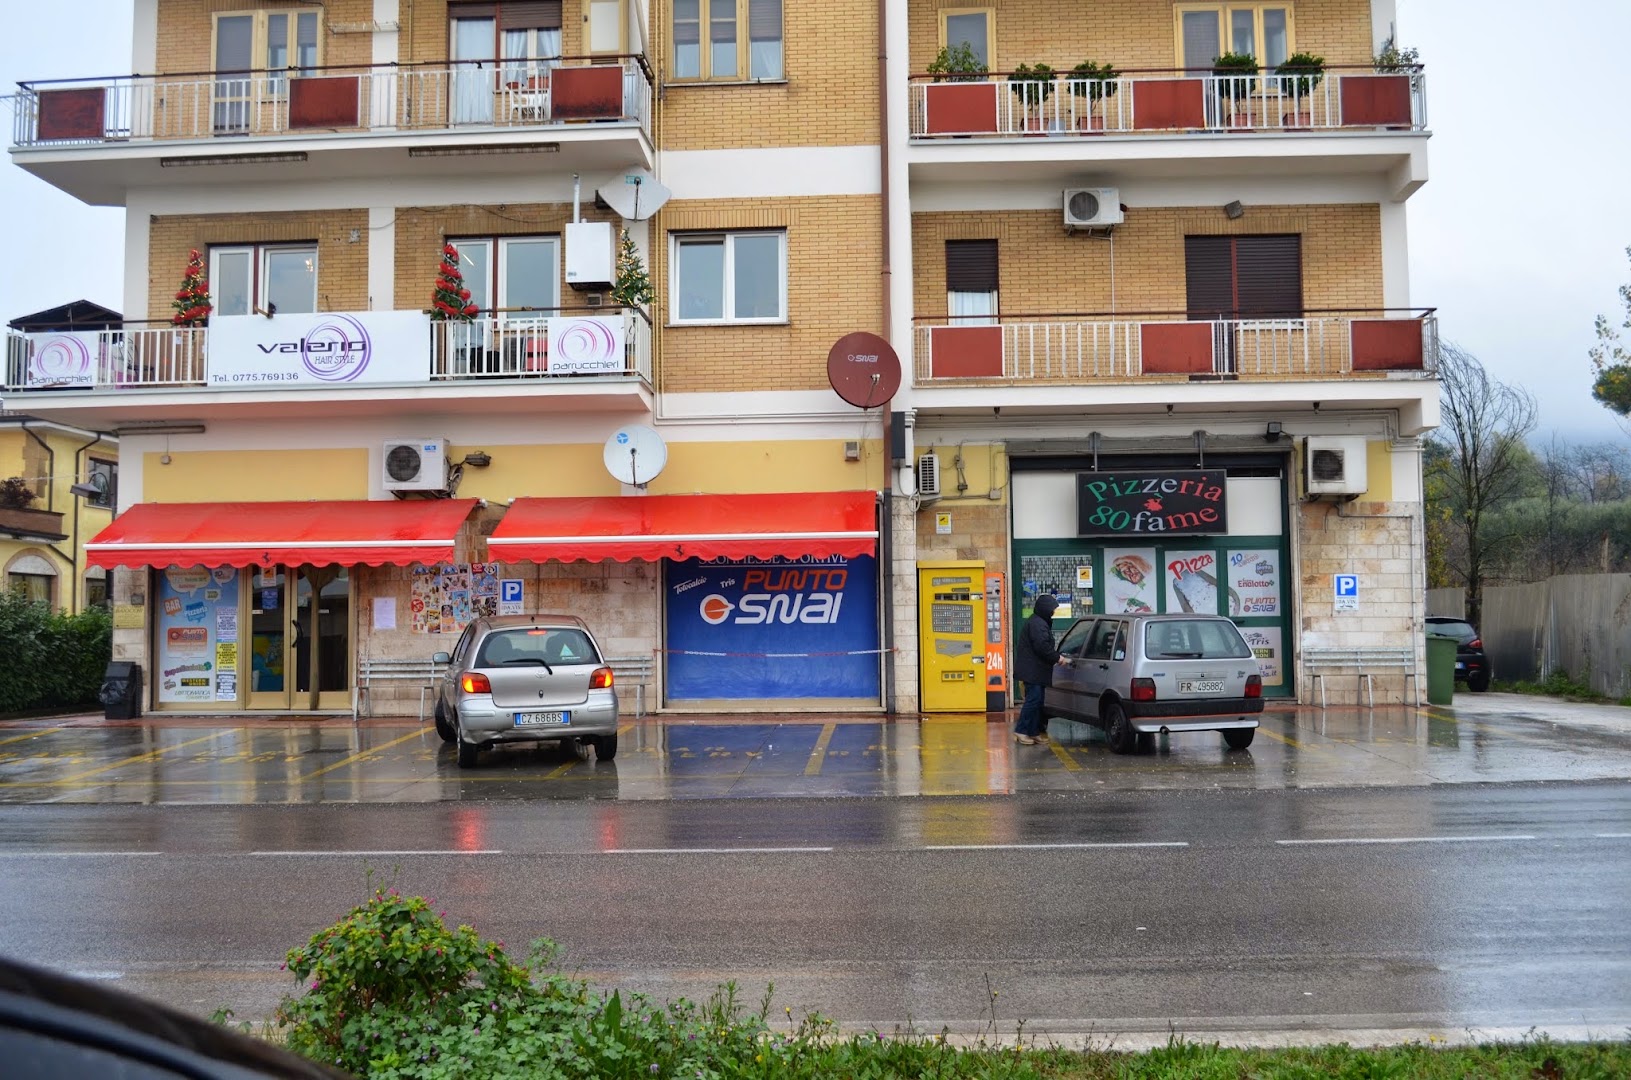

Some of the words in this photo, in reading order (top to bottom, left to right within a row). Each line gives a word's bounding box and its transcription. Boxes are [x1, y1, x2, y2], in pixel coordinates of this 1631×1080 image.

[257, 338, 367, 354] valerio
[314, 356, 333, 364] HAIR
[334, 355, 356, 364] STYLE
[553, 360, 619, 371] parrucchieri
[212, 374, 230, 382] Tel.
[232, 373, 299, 382] 0775.769136
[1085, 476, 1223, 502] Pizzeria
[1167, 553, 1214, 580] Pizza
[1231, 553, 1243, 567] 10
[673, 575, 708, 595] Totocalcio
[720, 577, 736, 589] Tris
[743, 569, 848, 591] PUNTO
[1340, 577, 1355, 595] P
[505, 582, 520, 600] P
[164, 599, 181, 613] BAR
[1244, 597, 1277, 605] PUNTO
[184, 605, 208, 617] Pizzeria
[1250, 637, 1270, 645] Tris
[986, 651, 1003, 670] 24h
[1180, 682, 1192, 691] FR
[1197, 681, 1224, 692] 495882
[521, 714, 532, 723] CZ
[535, 712, 563, 723] 686BS
